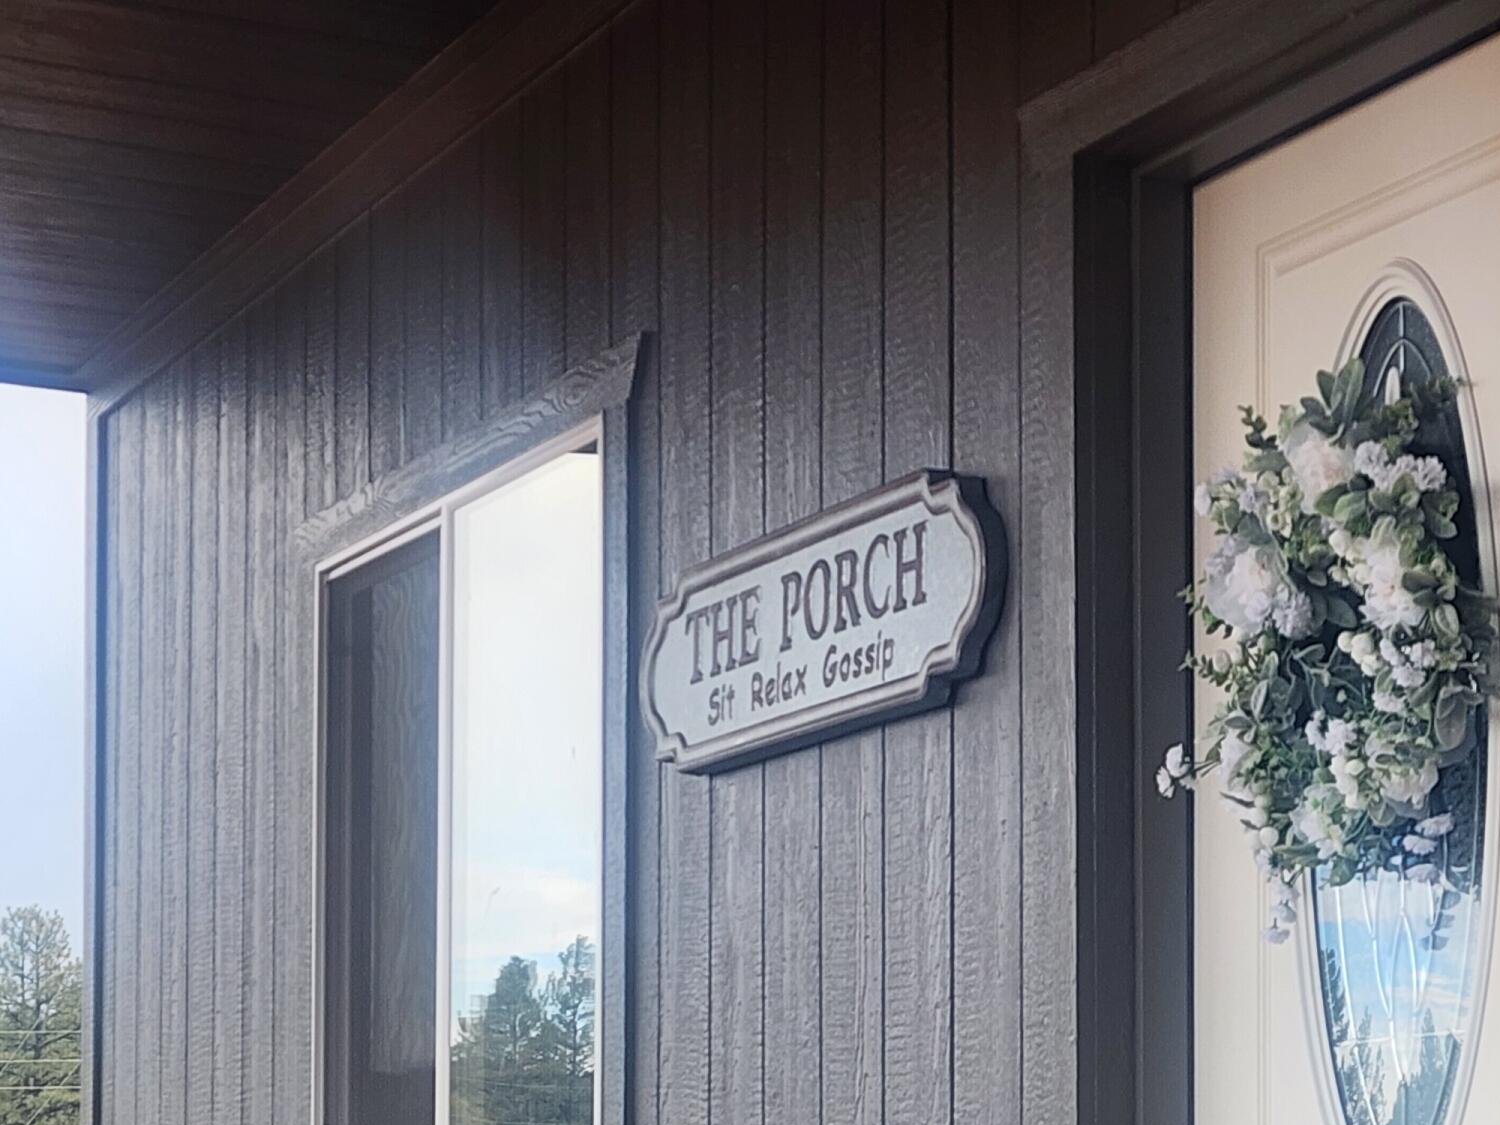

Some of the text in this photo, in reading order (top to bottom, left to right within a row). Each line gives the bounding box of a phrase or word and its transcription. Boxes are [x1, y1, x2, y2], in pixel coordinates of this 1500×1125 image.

[684, 521, 928, 685] THE PORCH
[707, 629, 895, 727] Sit Relax Gossip
